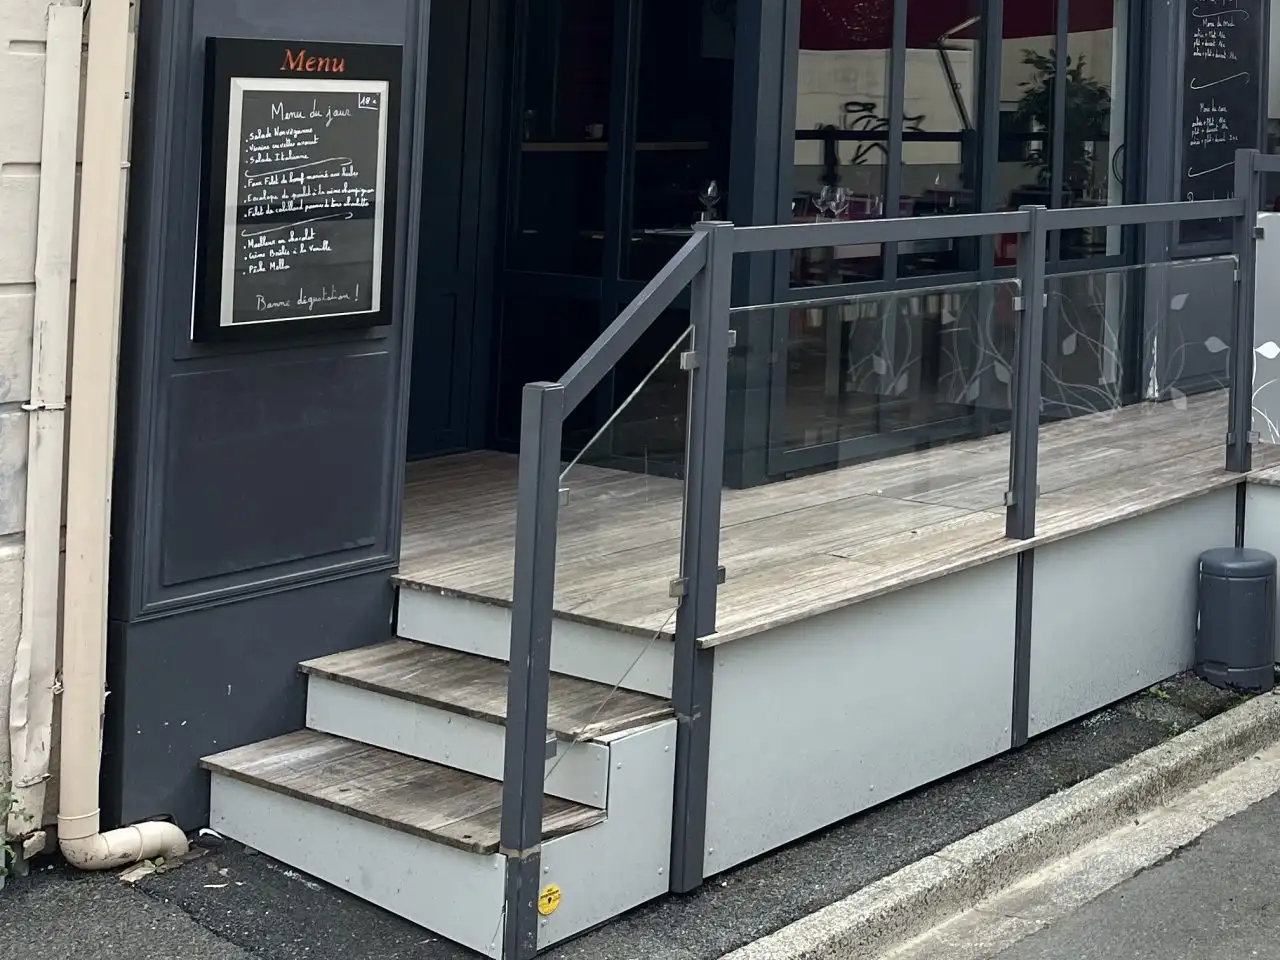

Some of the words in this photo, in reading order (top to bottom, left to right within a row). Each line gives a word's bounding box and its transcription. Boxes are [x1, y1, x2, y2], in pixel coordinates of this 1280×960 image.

[280, 48, 346, 73] Menu
[271, 101, 306, 120] Menu
[309, 99, 323, 117] du
[325, 106, 352, 127] jour
